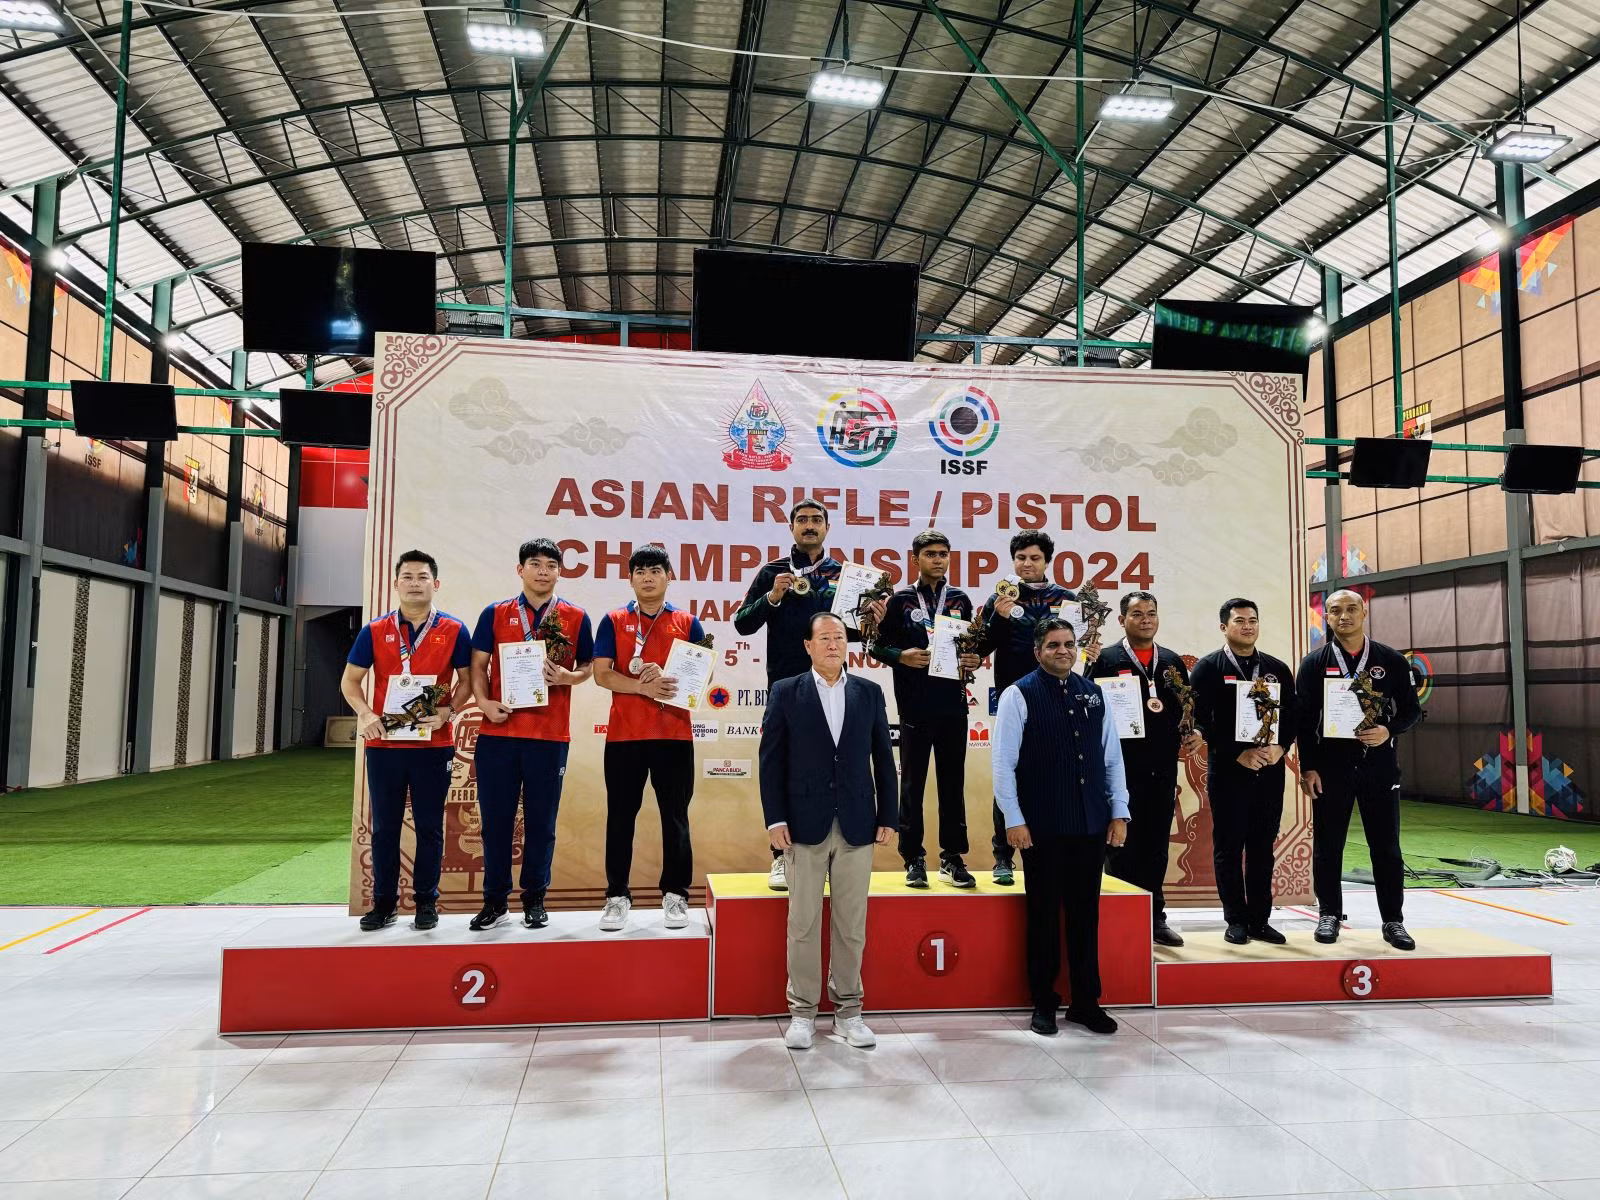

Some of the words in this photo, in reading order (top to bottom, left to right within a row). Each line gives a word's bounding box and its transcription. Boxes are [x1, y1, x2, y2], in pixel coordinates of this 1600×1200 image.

[85, 453, 102, 469] ISSF
[941, 459, 988, 475] ISSF
[545, 477, 729, 521] ASIAN
[929, 490, 942, 528] /
[962, 492, 1157, 532] PISTOL
[556, 539, 999, 588] CHMPSIP
[724, 650, 738, 667] 5
[738, 690, 752, 706] PT.
[726, 725, 759, 735] BANK
[931, 938, 944, 971] 1
[462, 969, 486, 1004] 2
[1352, 965, 1372, 996] 3
